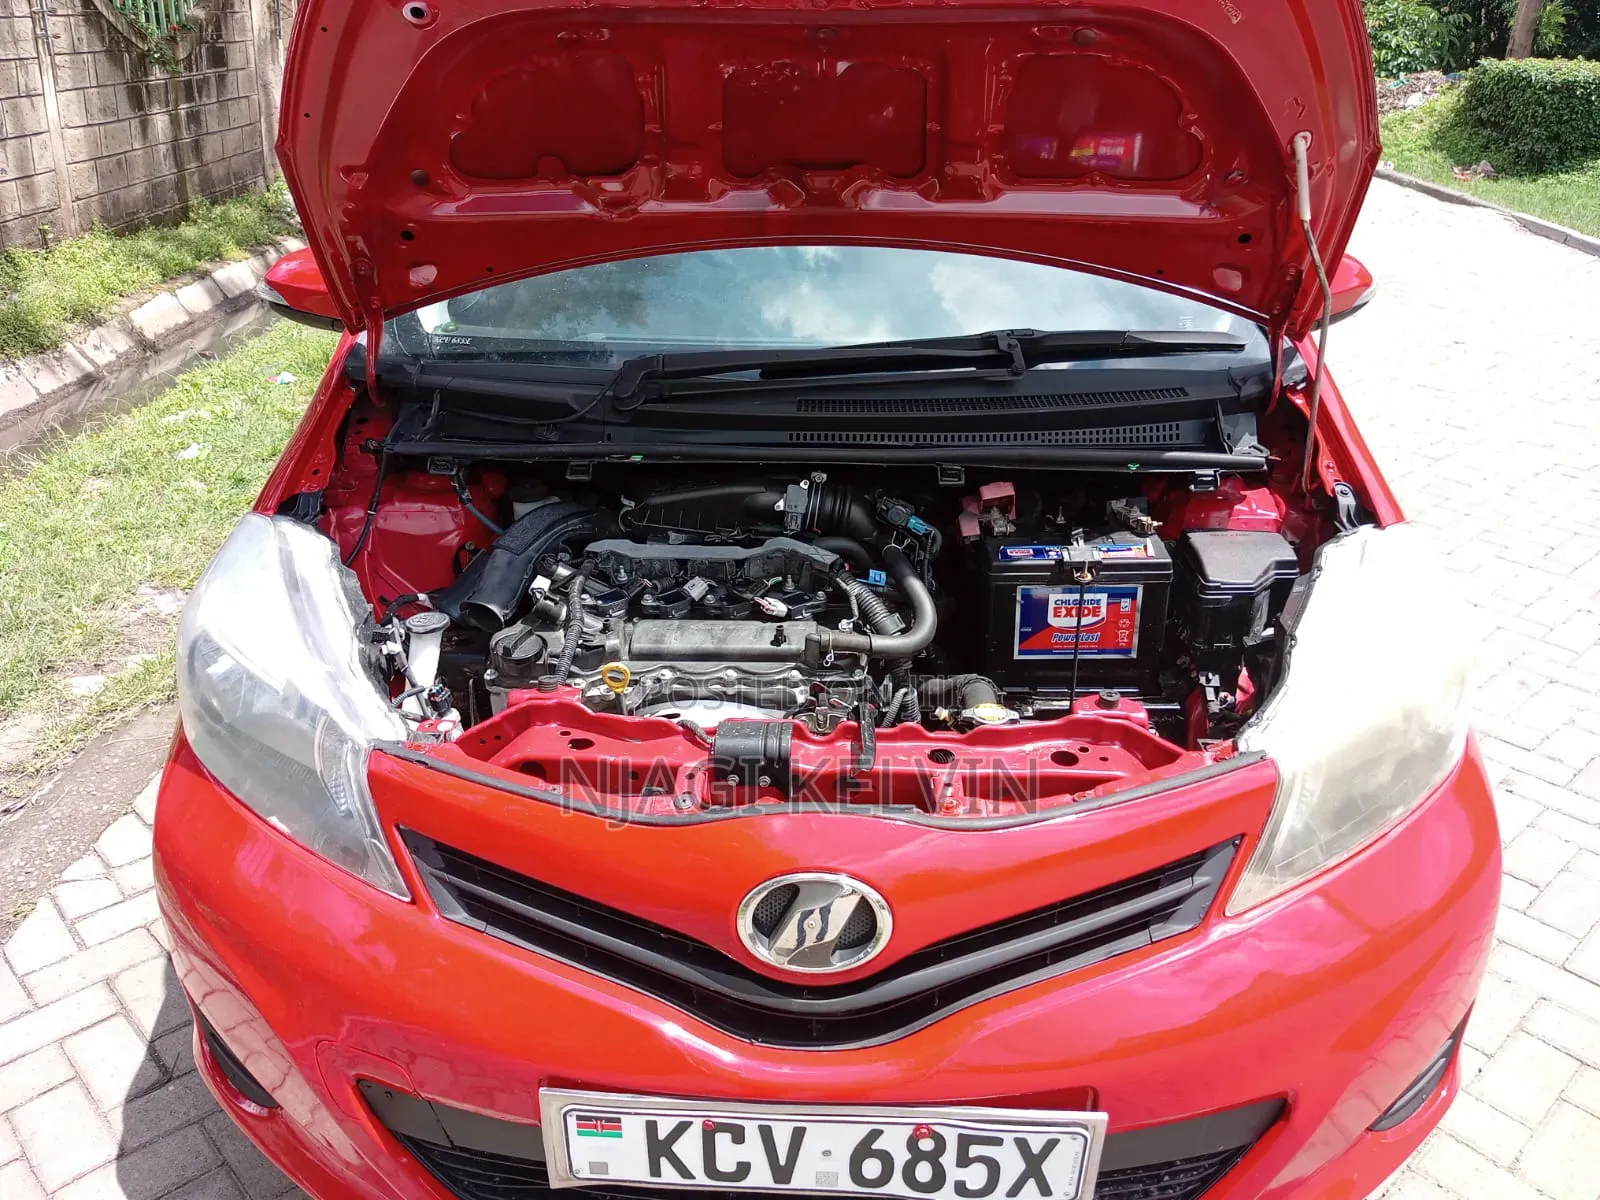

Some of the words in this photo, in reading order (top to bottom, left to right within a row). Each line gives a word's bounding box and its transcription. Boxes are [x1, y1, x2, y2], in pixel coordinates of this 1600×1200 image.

[1054, 598, 1102, 606] CHLORIDE
[1053, 606, 1102, 618] EXIDE
[1051, 632, 1101, 643] PoweLast
[645, 1119, 807, 1185] KCV
[849, 1126, 1060, 1198] 685X
